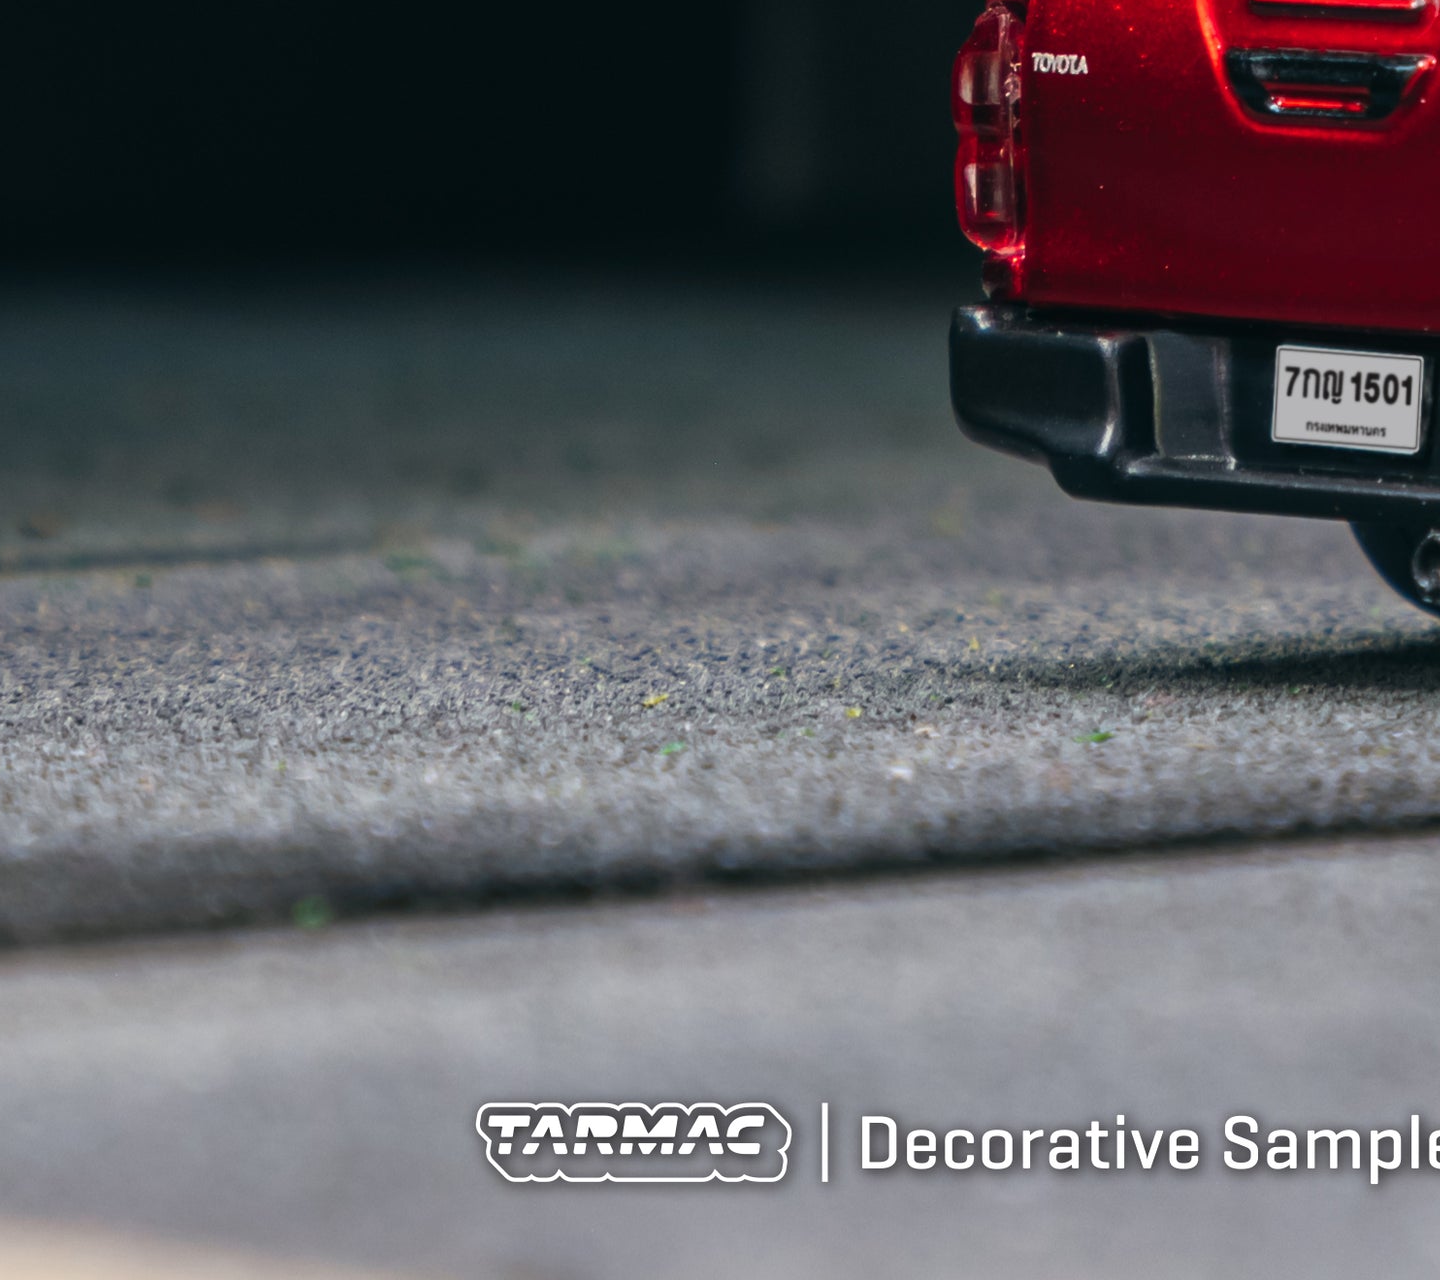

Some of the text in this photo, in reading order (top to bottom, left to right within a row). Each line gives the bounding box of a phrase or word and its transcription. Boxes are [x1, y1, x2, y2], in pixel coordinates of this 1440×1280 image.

[1032, 52, 1089, 75] TOYOTA
[1285, 366, 1413, 406] 7กญ 1501
